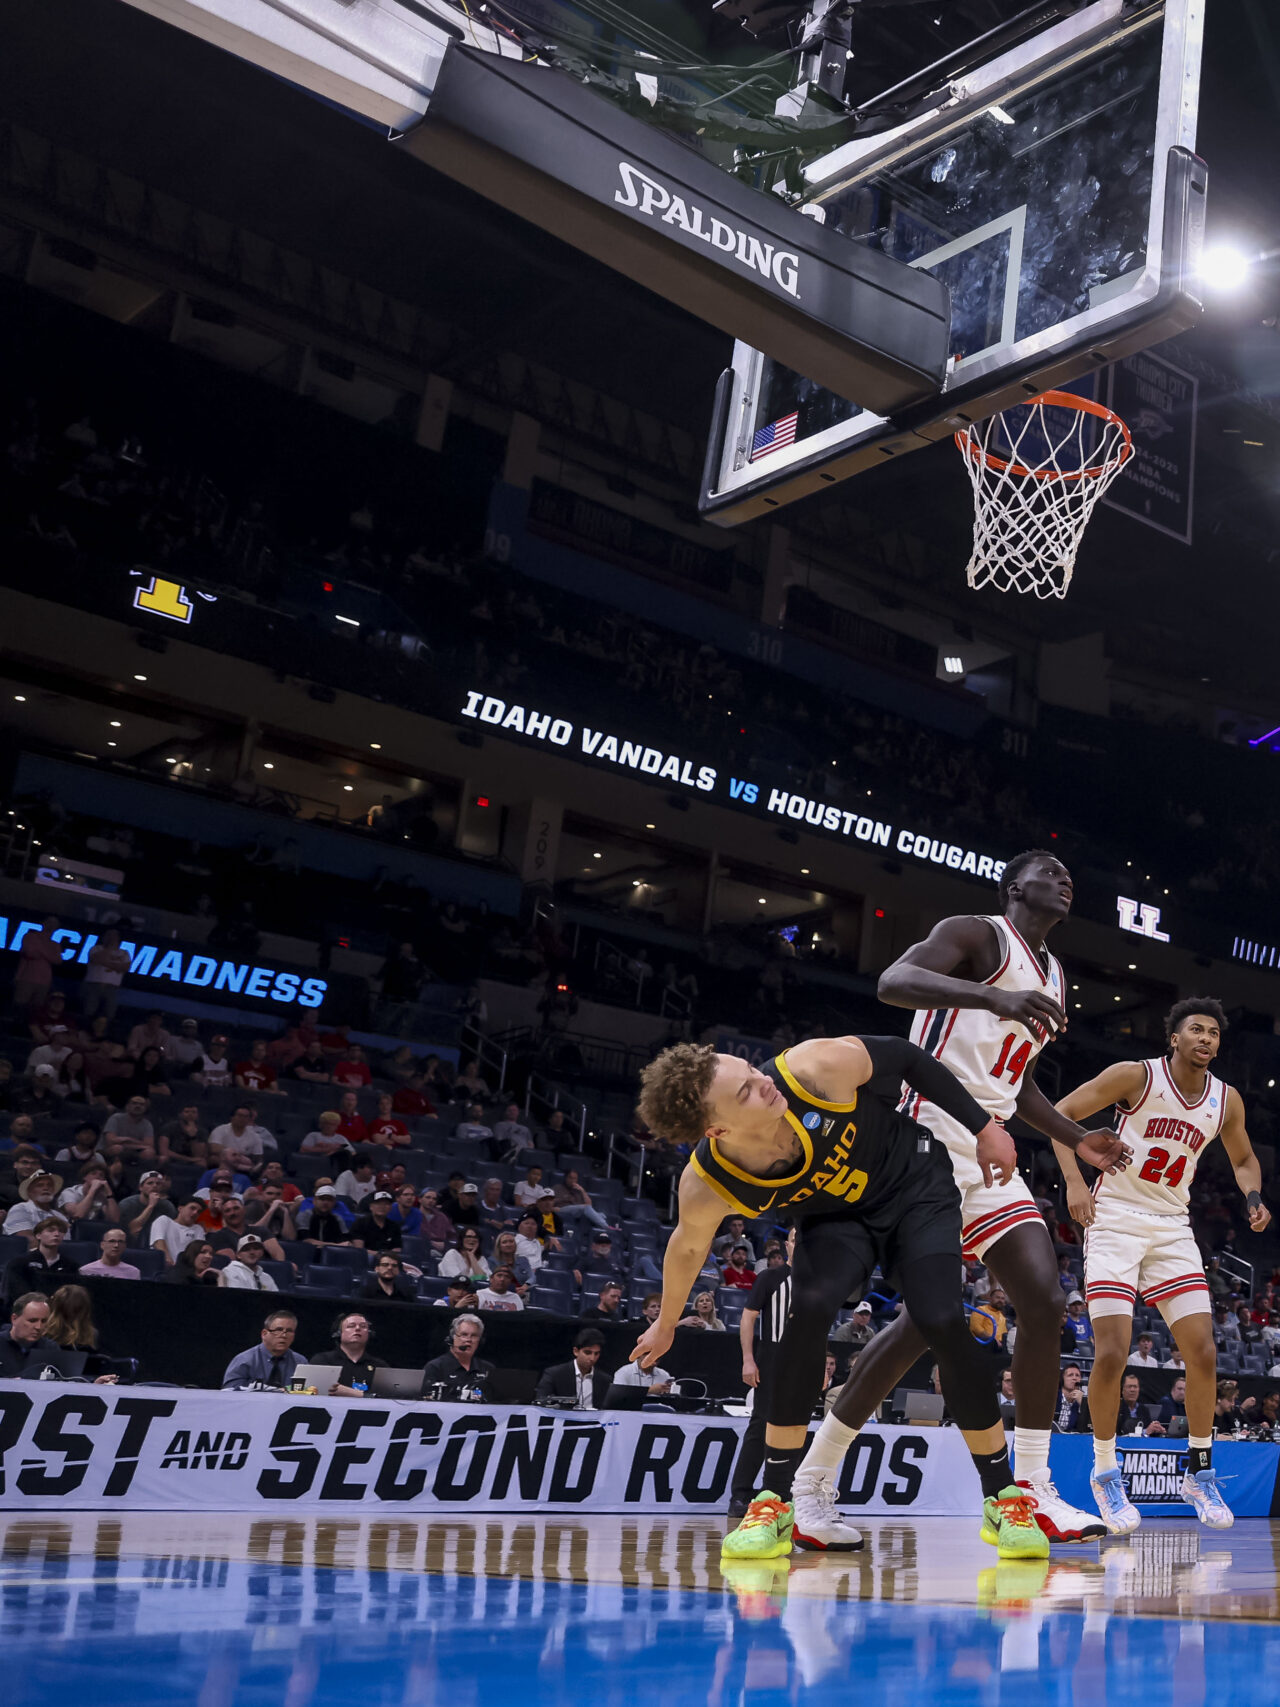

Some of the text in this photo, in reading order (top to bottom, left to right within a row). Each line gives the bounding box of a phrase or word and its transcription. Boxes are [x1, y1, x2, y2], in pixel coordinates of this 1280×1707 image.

[614, 161, 801, 299] SPALDING
[1136, 444, 1179, 475] 24-2025
[1138, 461, 1161, 482] NBA
[1121, 466, 1181, 504] HAMPIONS
[461, 690, 1008, 883] IDAHO VANDALS VS HOUSTON COUGARS
[120, 941, 327, 1008] MADNESS
[989, 1032, 1034, 1087] 14
[1143, 1117, 1206, 1155] HOUSTON
[823, 1165, 869, 1204] 5
[1138, 1146, 1188, 1188] 24
[159, 1430, 252, 1470] AND
[256, 1406, 607, 1501] SECOND
[623, 1423, 929, 1506] RODS
[1123, 1453, 1177, 1474] MARCH
[1131, 1474, 1185, 1496] MADNE
